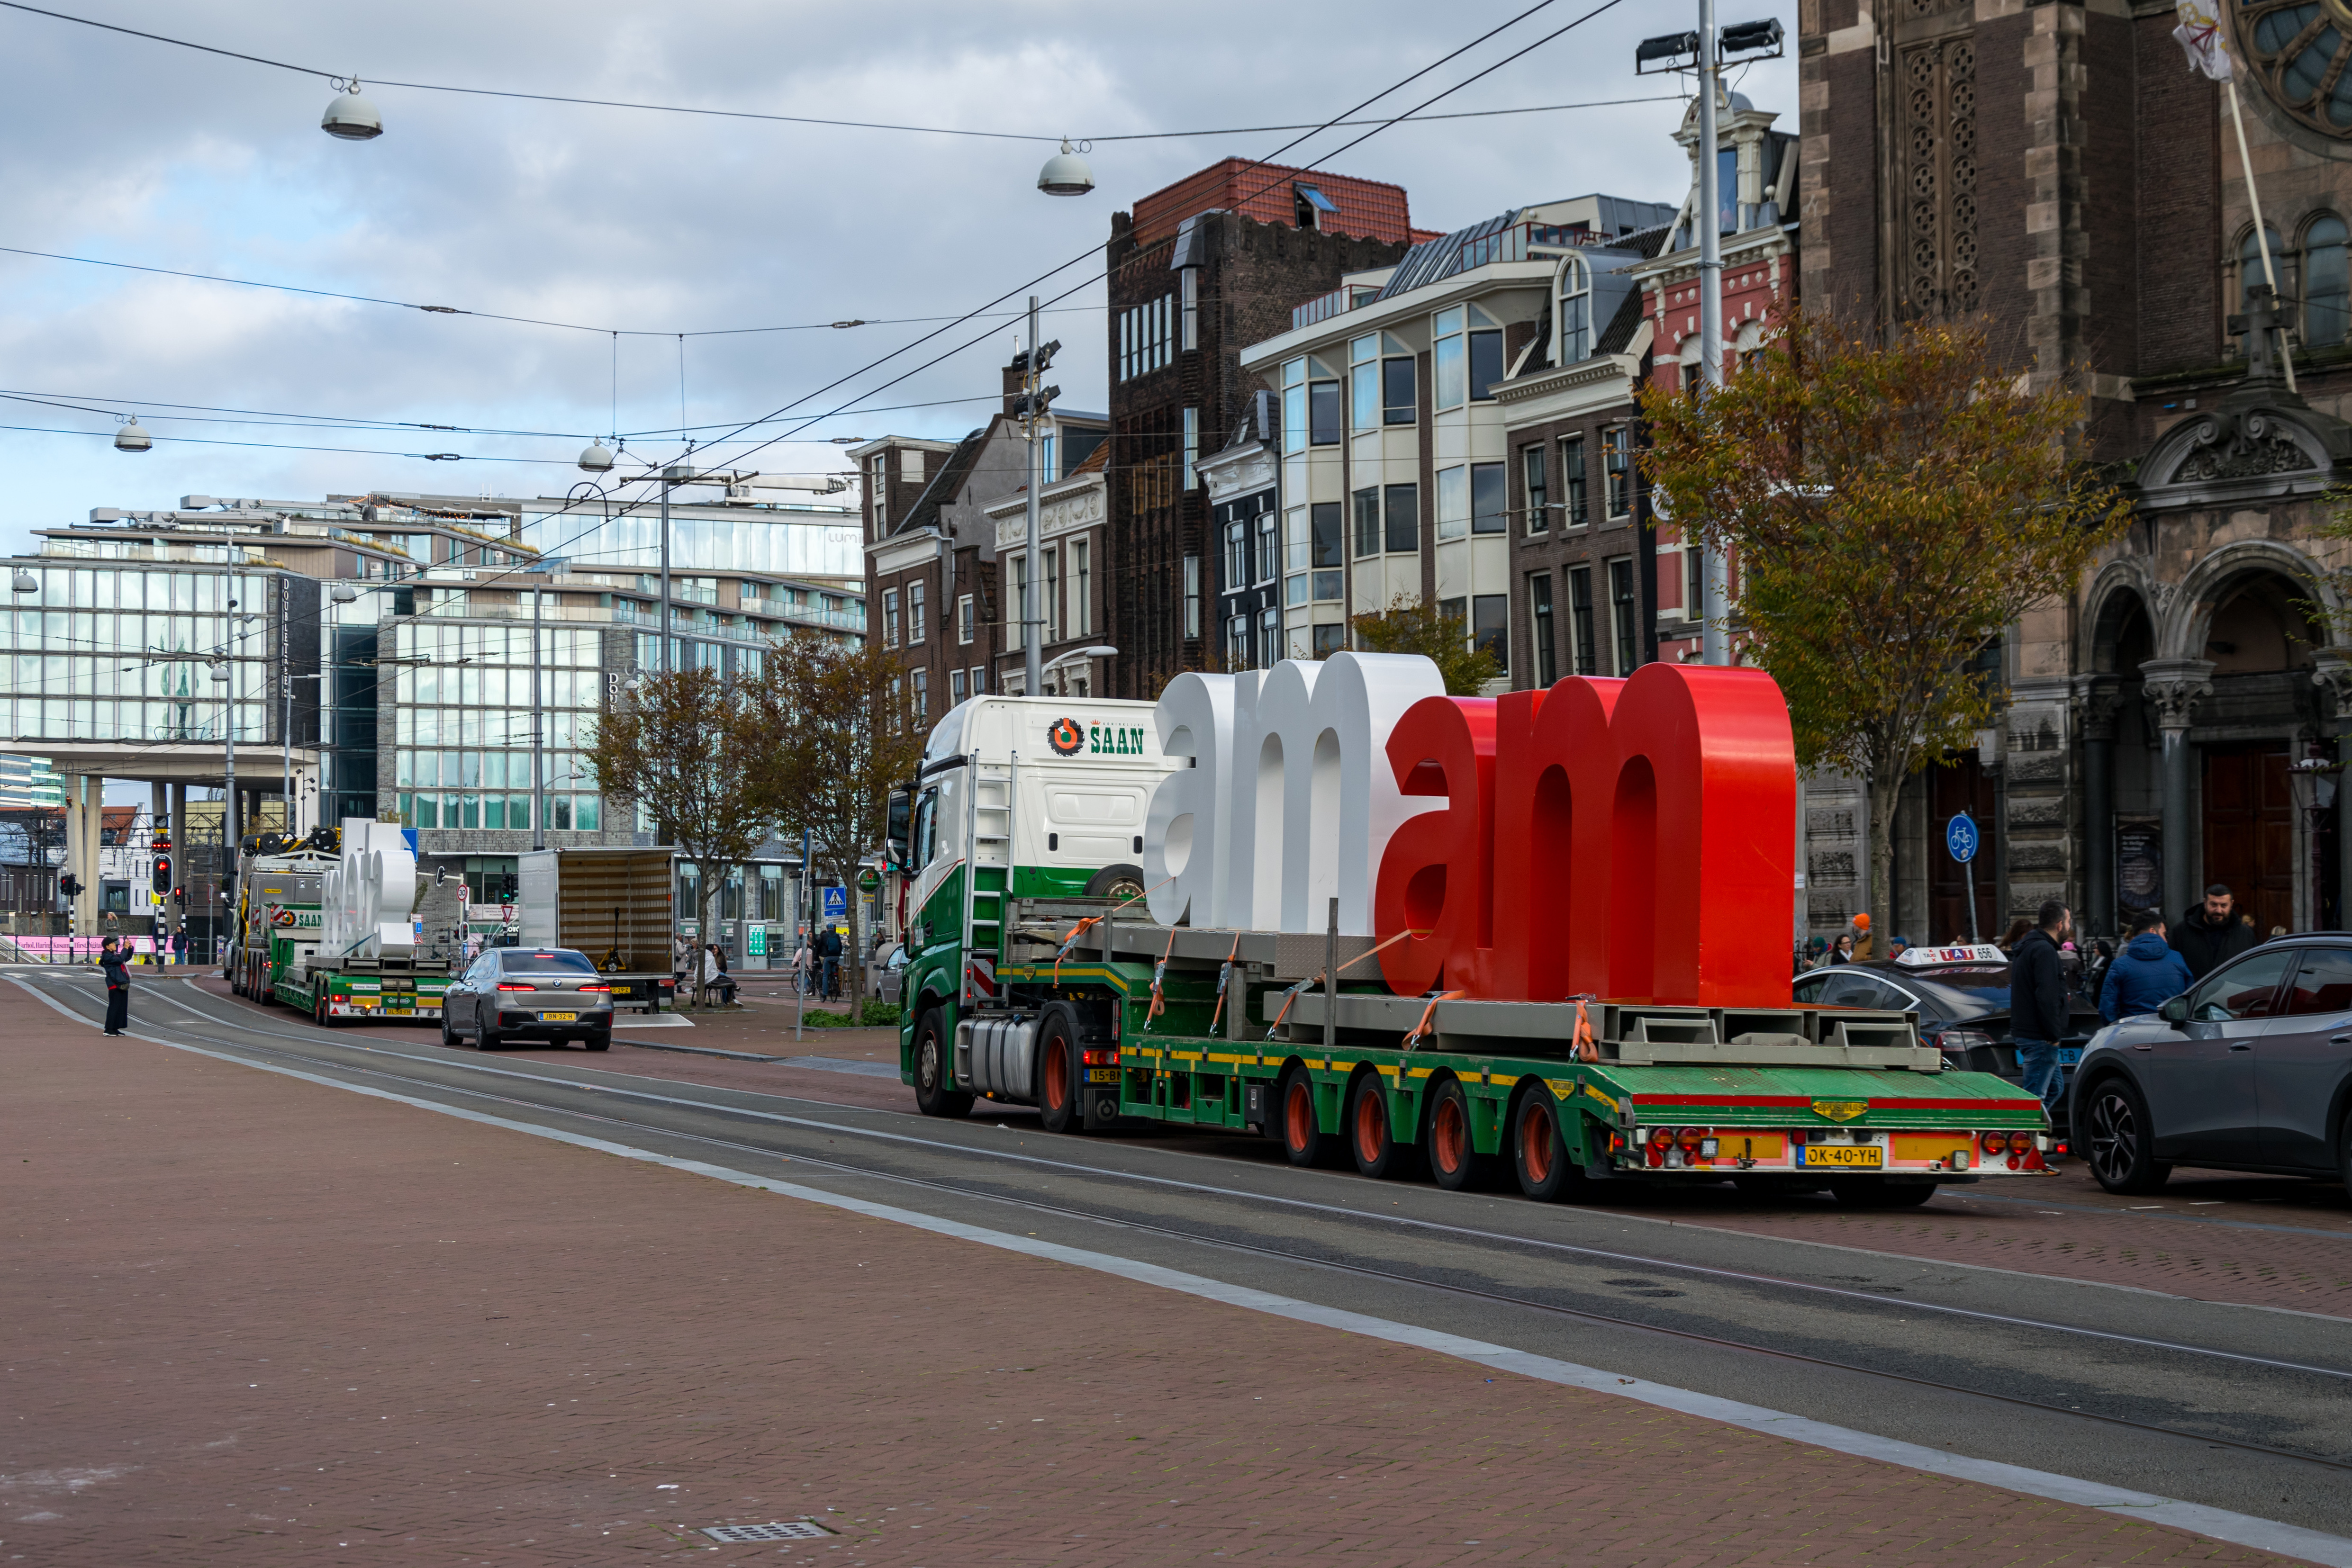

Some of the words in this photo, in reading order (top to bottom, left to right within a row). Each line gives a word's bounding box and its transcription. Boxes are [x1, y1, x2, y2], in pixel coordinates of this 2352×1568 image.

[1090, 726, 1144, 755] SAAN
[1375, 662, 1796, 1008] am
[1941, 948, 1971, 959] TAT
[1977, 947, 1992, 959] 656
[1818, 1102, 1864, 1112] BROSHUIS
[1809, 1149, 1877, 1163] OK-40-YH
